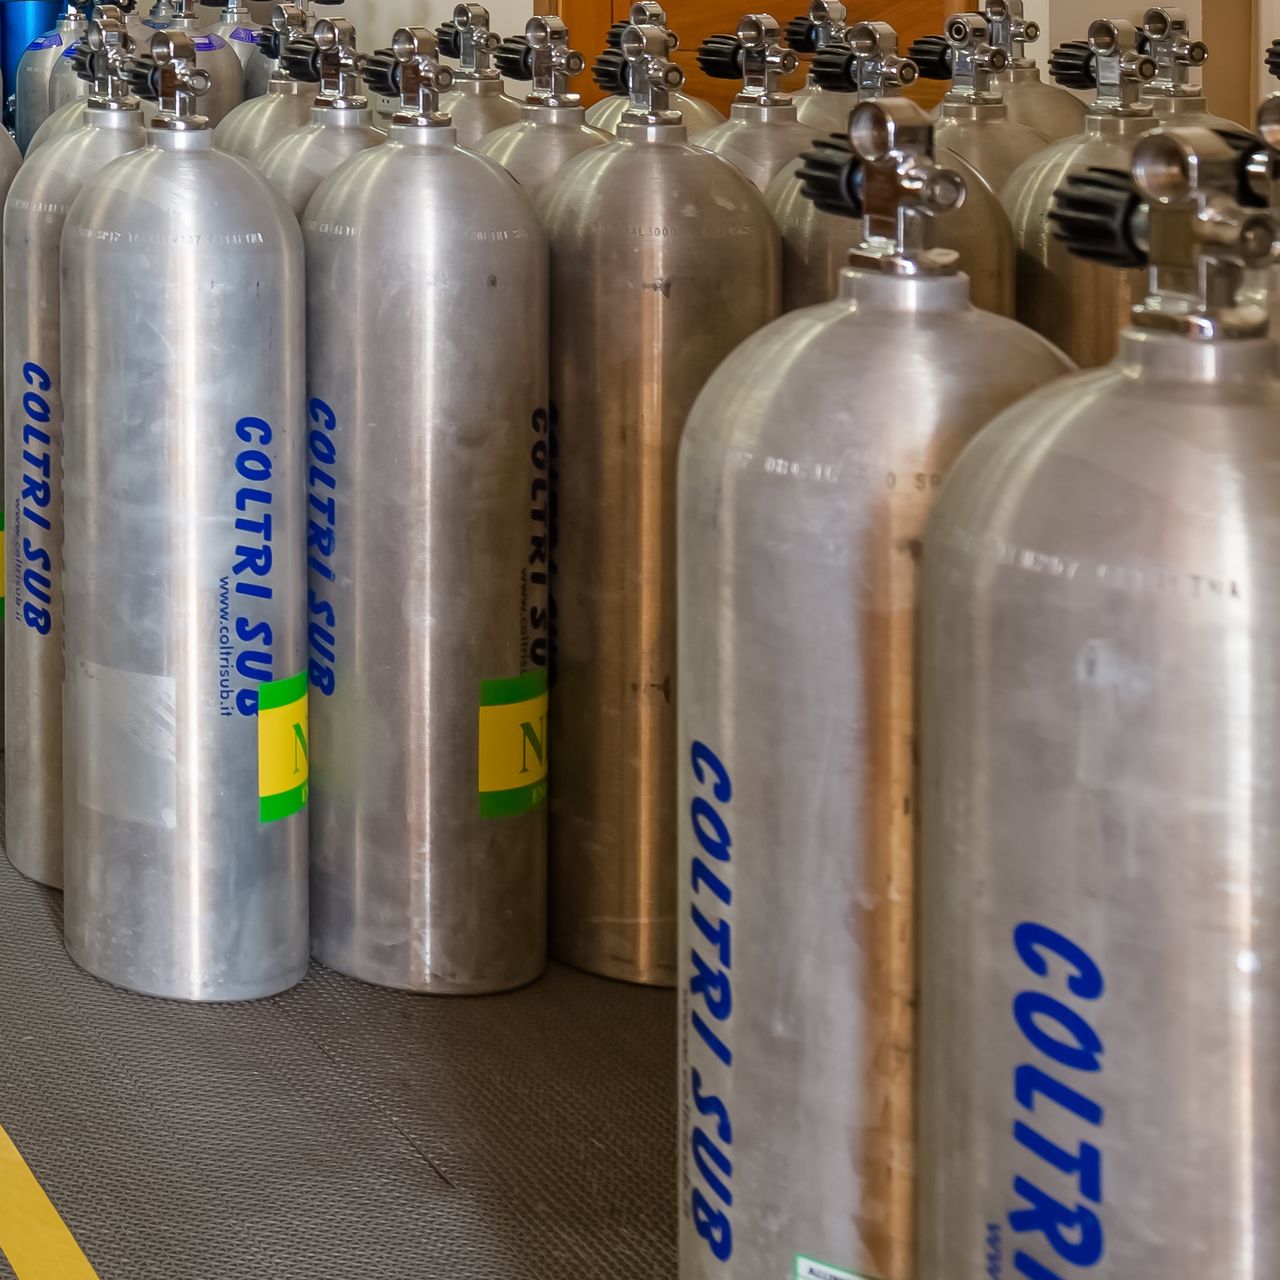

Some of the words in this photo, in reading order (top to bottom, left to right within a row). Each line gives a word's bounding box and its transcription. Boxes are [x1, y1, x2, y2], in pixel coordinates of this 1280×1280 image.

[22, 360, 52, 531] COLTRI
[232, 415, 273, 600] COLTRI
[307, 396, 337, 580] COLTRI
[22, 537, 52, 636] SUB
[219, 576, 233, 717] www.coltrisub.it
[307, 588, 337, 697] SUB
[529, 605, 548, 668] SU
[235, 616, 274, 718] SUB
[690, 740, 733, 1067] COLTRI
[690, 1066, 733, 1263] SUB
